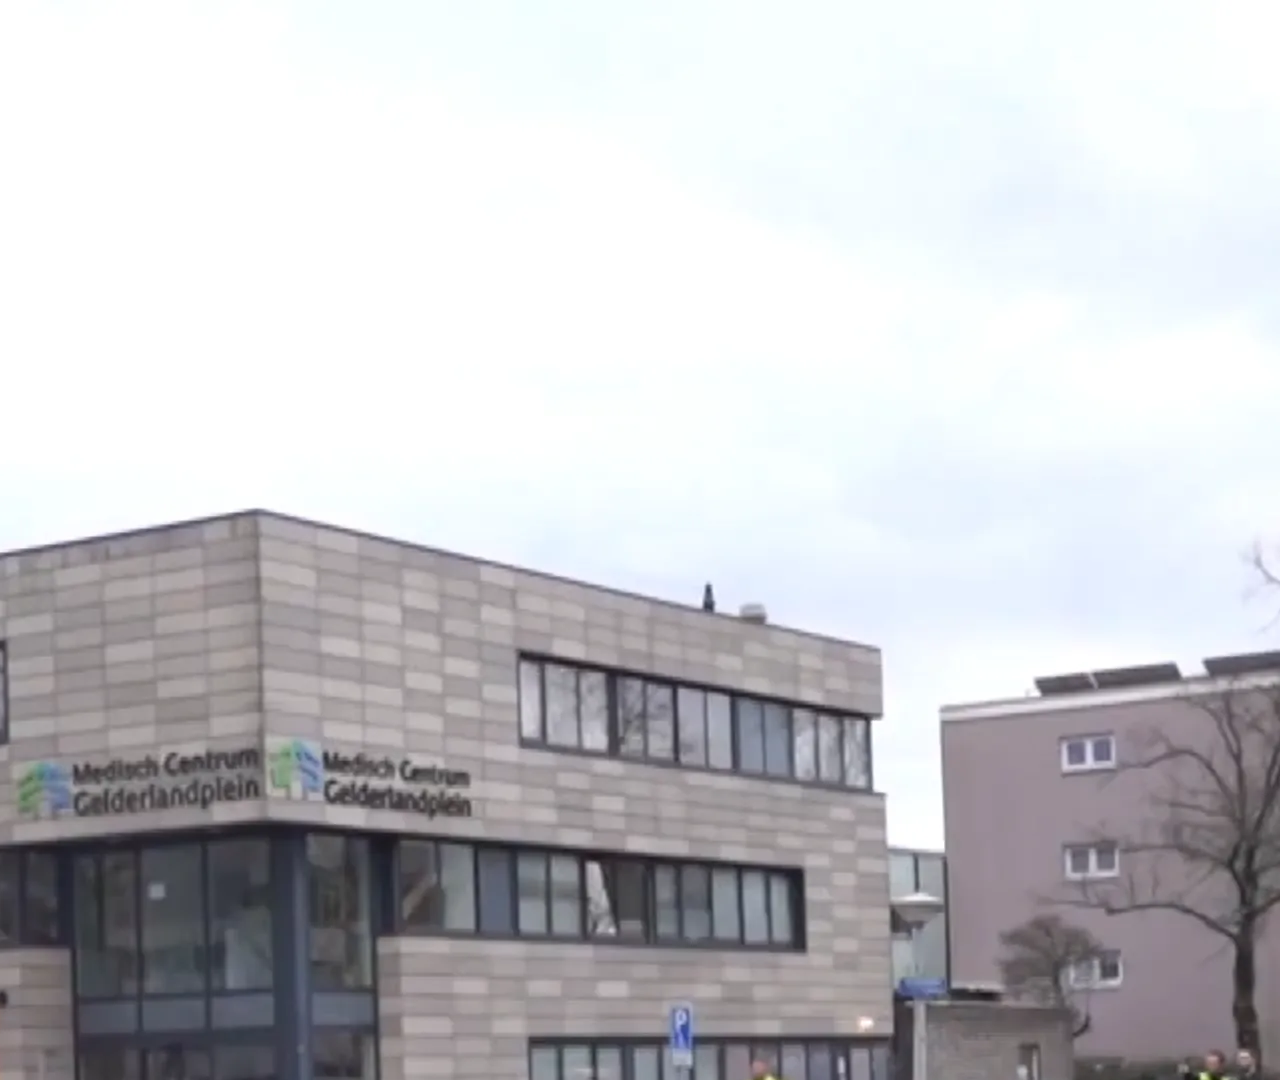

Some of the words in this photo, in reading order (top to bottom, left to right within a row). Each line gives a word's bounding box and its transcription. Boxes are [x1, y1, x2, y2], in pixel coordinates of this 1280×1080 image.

[73, 755, 159, 785] Medisch
[163, 748, 260, 777] Centrum
[322, 749, 395, 780] Medisch
[399, 760, 471, 787] Centrum
[74, 773, 260, 817] Gelderlandplein
[324, 779, 472, 821] Gelderlandplein
